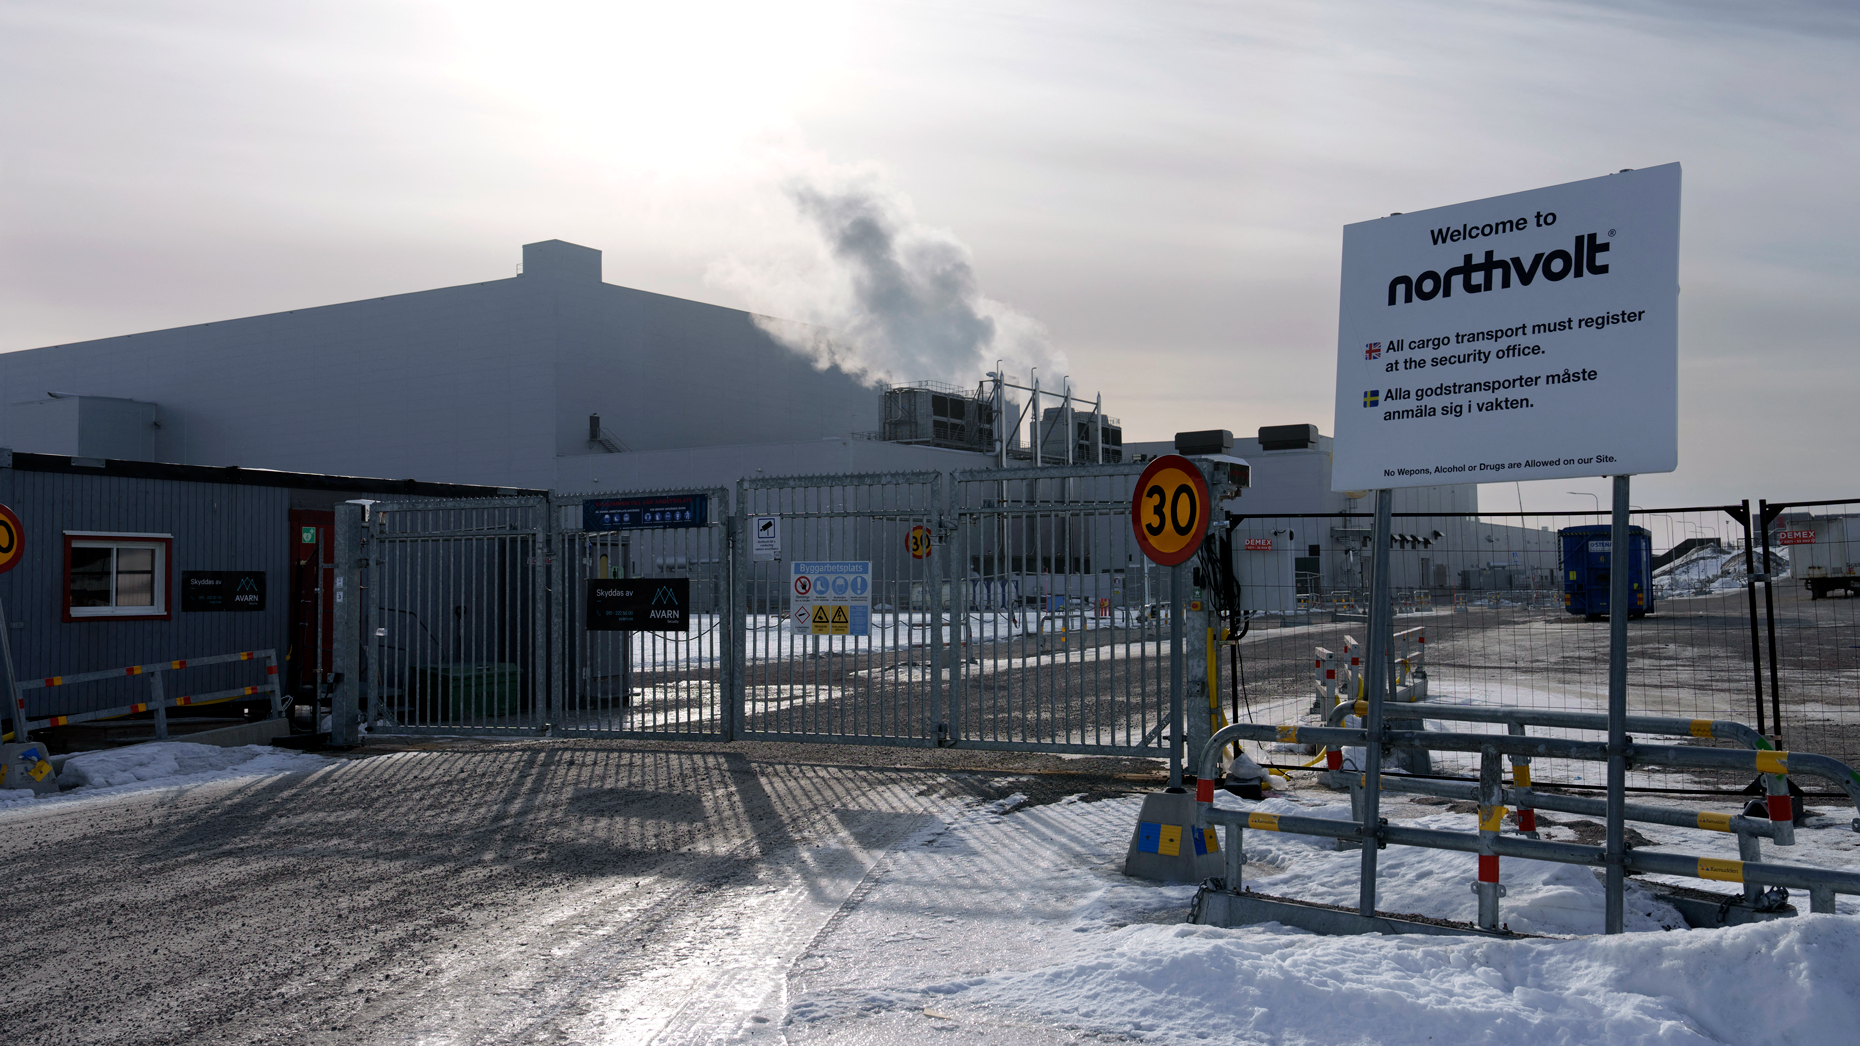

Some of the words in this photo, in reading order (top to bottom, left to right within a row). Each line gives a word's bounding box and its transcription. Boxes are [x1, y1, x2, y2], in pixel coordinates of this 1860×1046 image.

[1430, 217, 1528, 246] Welcome
[1534, 211, 1557, 228] to
[1388, 232, 1610, 306] northvolt
[1386, 340, 1404, 354] All
[1408, 336, 1450, 351] cargo
[1454, 324, 1527, 346] transport
[1532, 318, 1573, 334] must
[1578, 310, 1646, 330] register
[1385, 360, 1400, 372] at
[1403, 357, 1426, 370] the
[1430, 348, 1491, 368] security
[1496, 344, 1546, 360] office.
[1384, 388, 1410, 402] Alla
[1415, 375, 1541, 403] godstransporter
[1546, 368, 1598, 385] måste
[1384, 404, 1436, 421] anmäla
[1440, 402, 1464, 418] sig
[1468, 400, 1472, 414] i
[1476, 397, 1534, 412] vakten.
[1384, 468, 1396, 476] No
[1397, 467, 1432, 478] Wepons,
[1434, 464, 1466, 474] Alcohol
[1479, 462, 1505, 472] Drugs
[1524, 458, 1561, 468] Allowed
[1596, 454, 1617, 464] Site.
[1145, 484, 1197, 536] 30
[1780, 530, 1815, 539] DEMEX
[800, 564, 863, 574] Byggarbetsplats
[596, 588, 624, 598] Skyddas
[649, 610, 680, 619] AVARN
